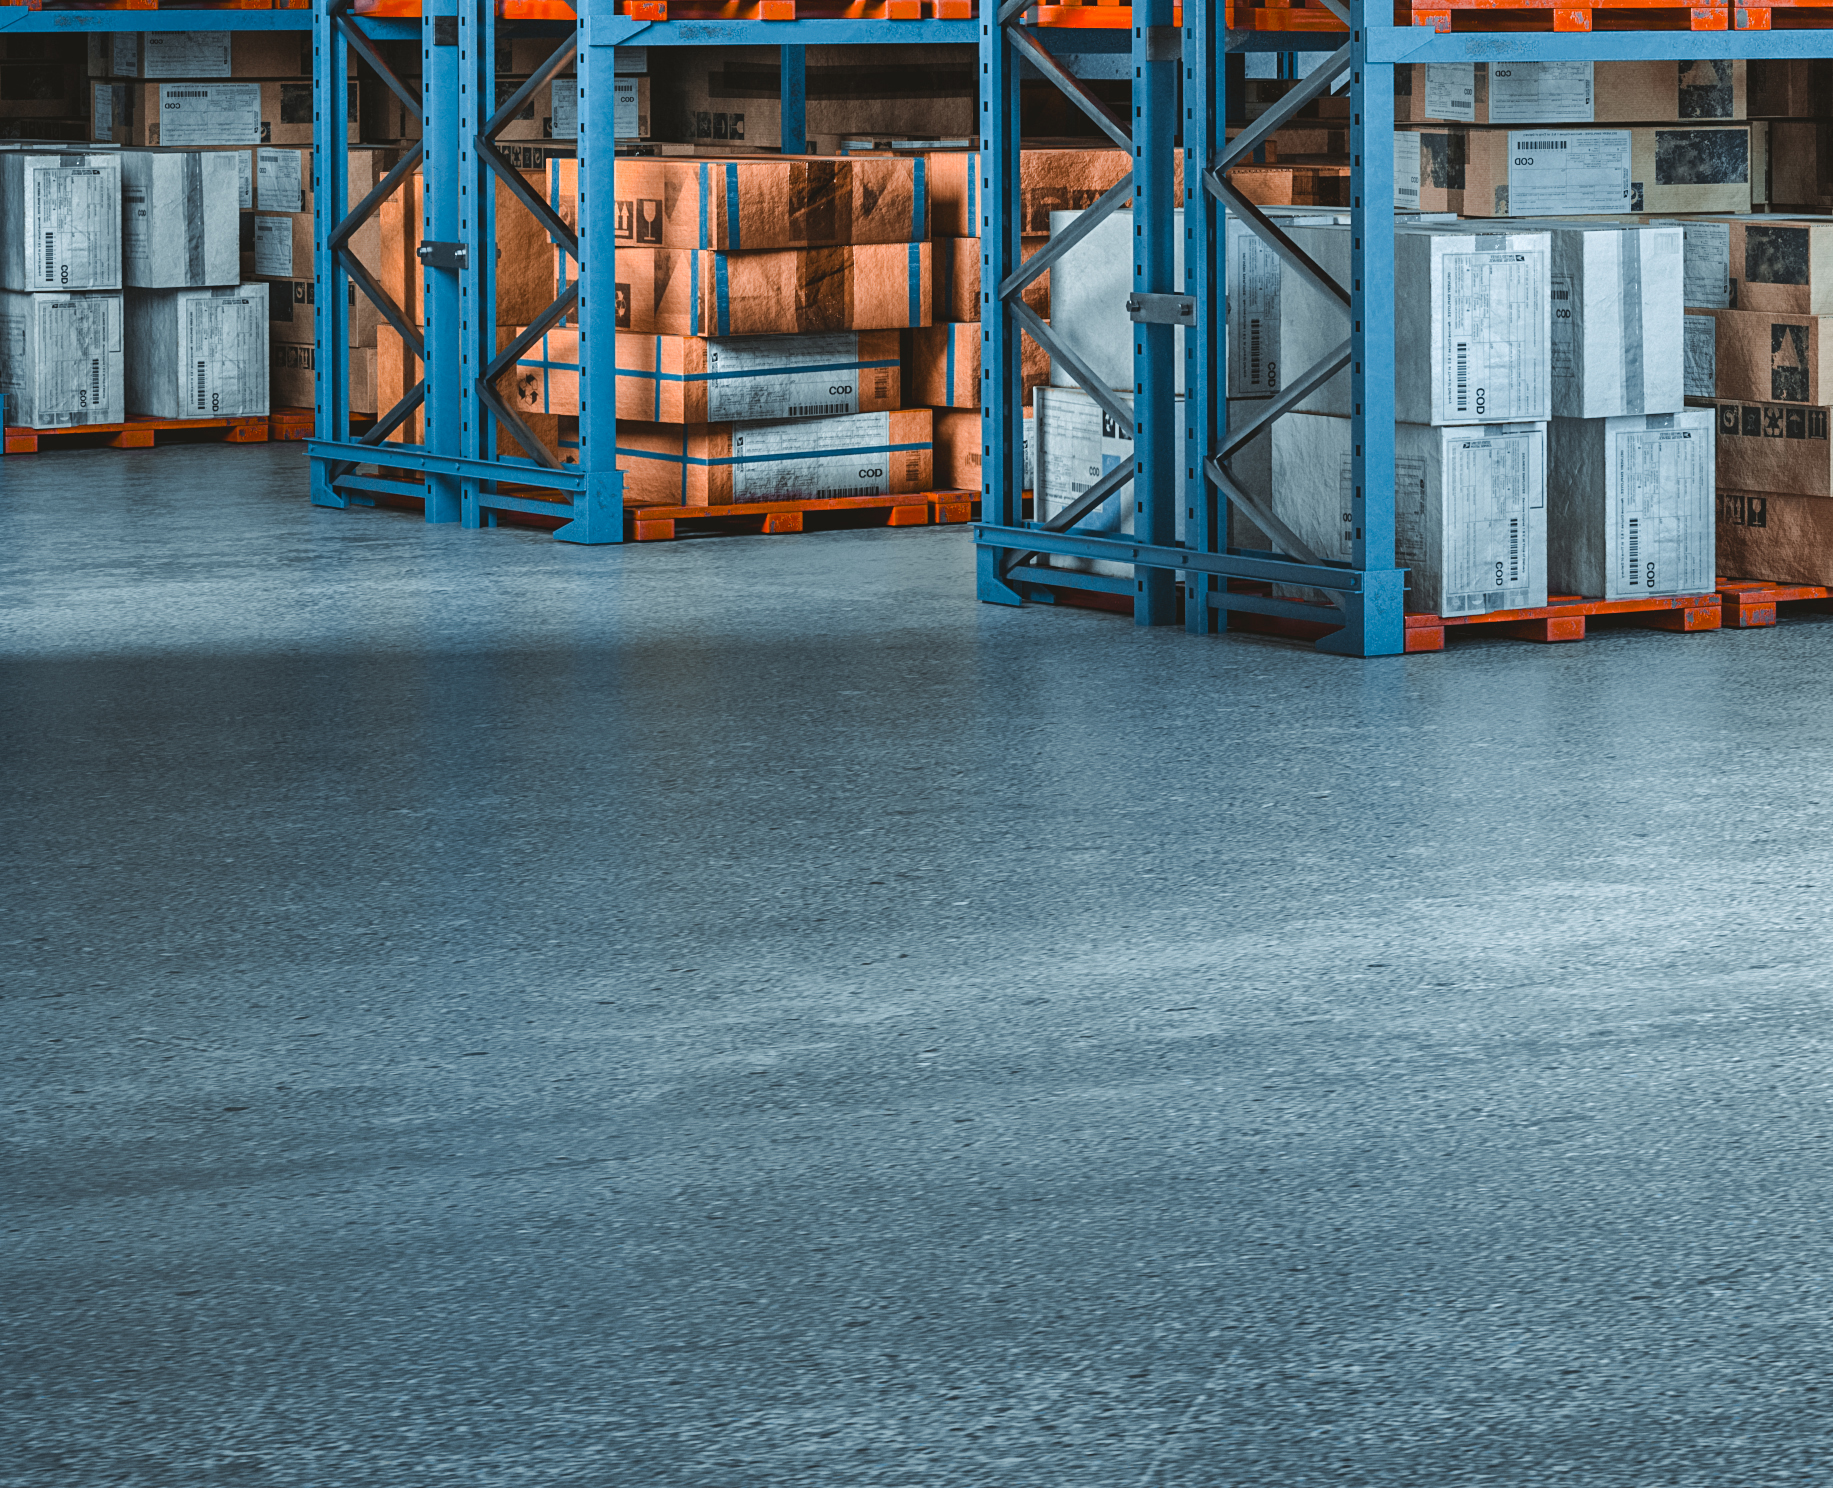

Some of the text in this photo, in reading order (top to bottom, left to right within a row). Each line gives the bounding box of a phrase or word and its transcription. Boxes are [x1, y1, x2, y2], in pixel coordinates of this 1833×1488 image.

[60, 264, 69, 284] COD
[1556, 308, 1570, 318] COD
[1267, 362, 1276, 387] COD
[79, 389, 87, 407] COD
[829, 385, 852, 396] COD
[211, 392, 219, 411] COD
[1476, 388, 1485, 414] COD
[859, 468, 882, 478] COD
[1495, 561, 1503, 586] COD
[1646, 562, 1654, 588] COD
